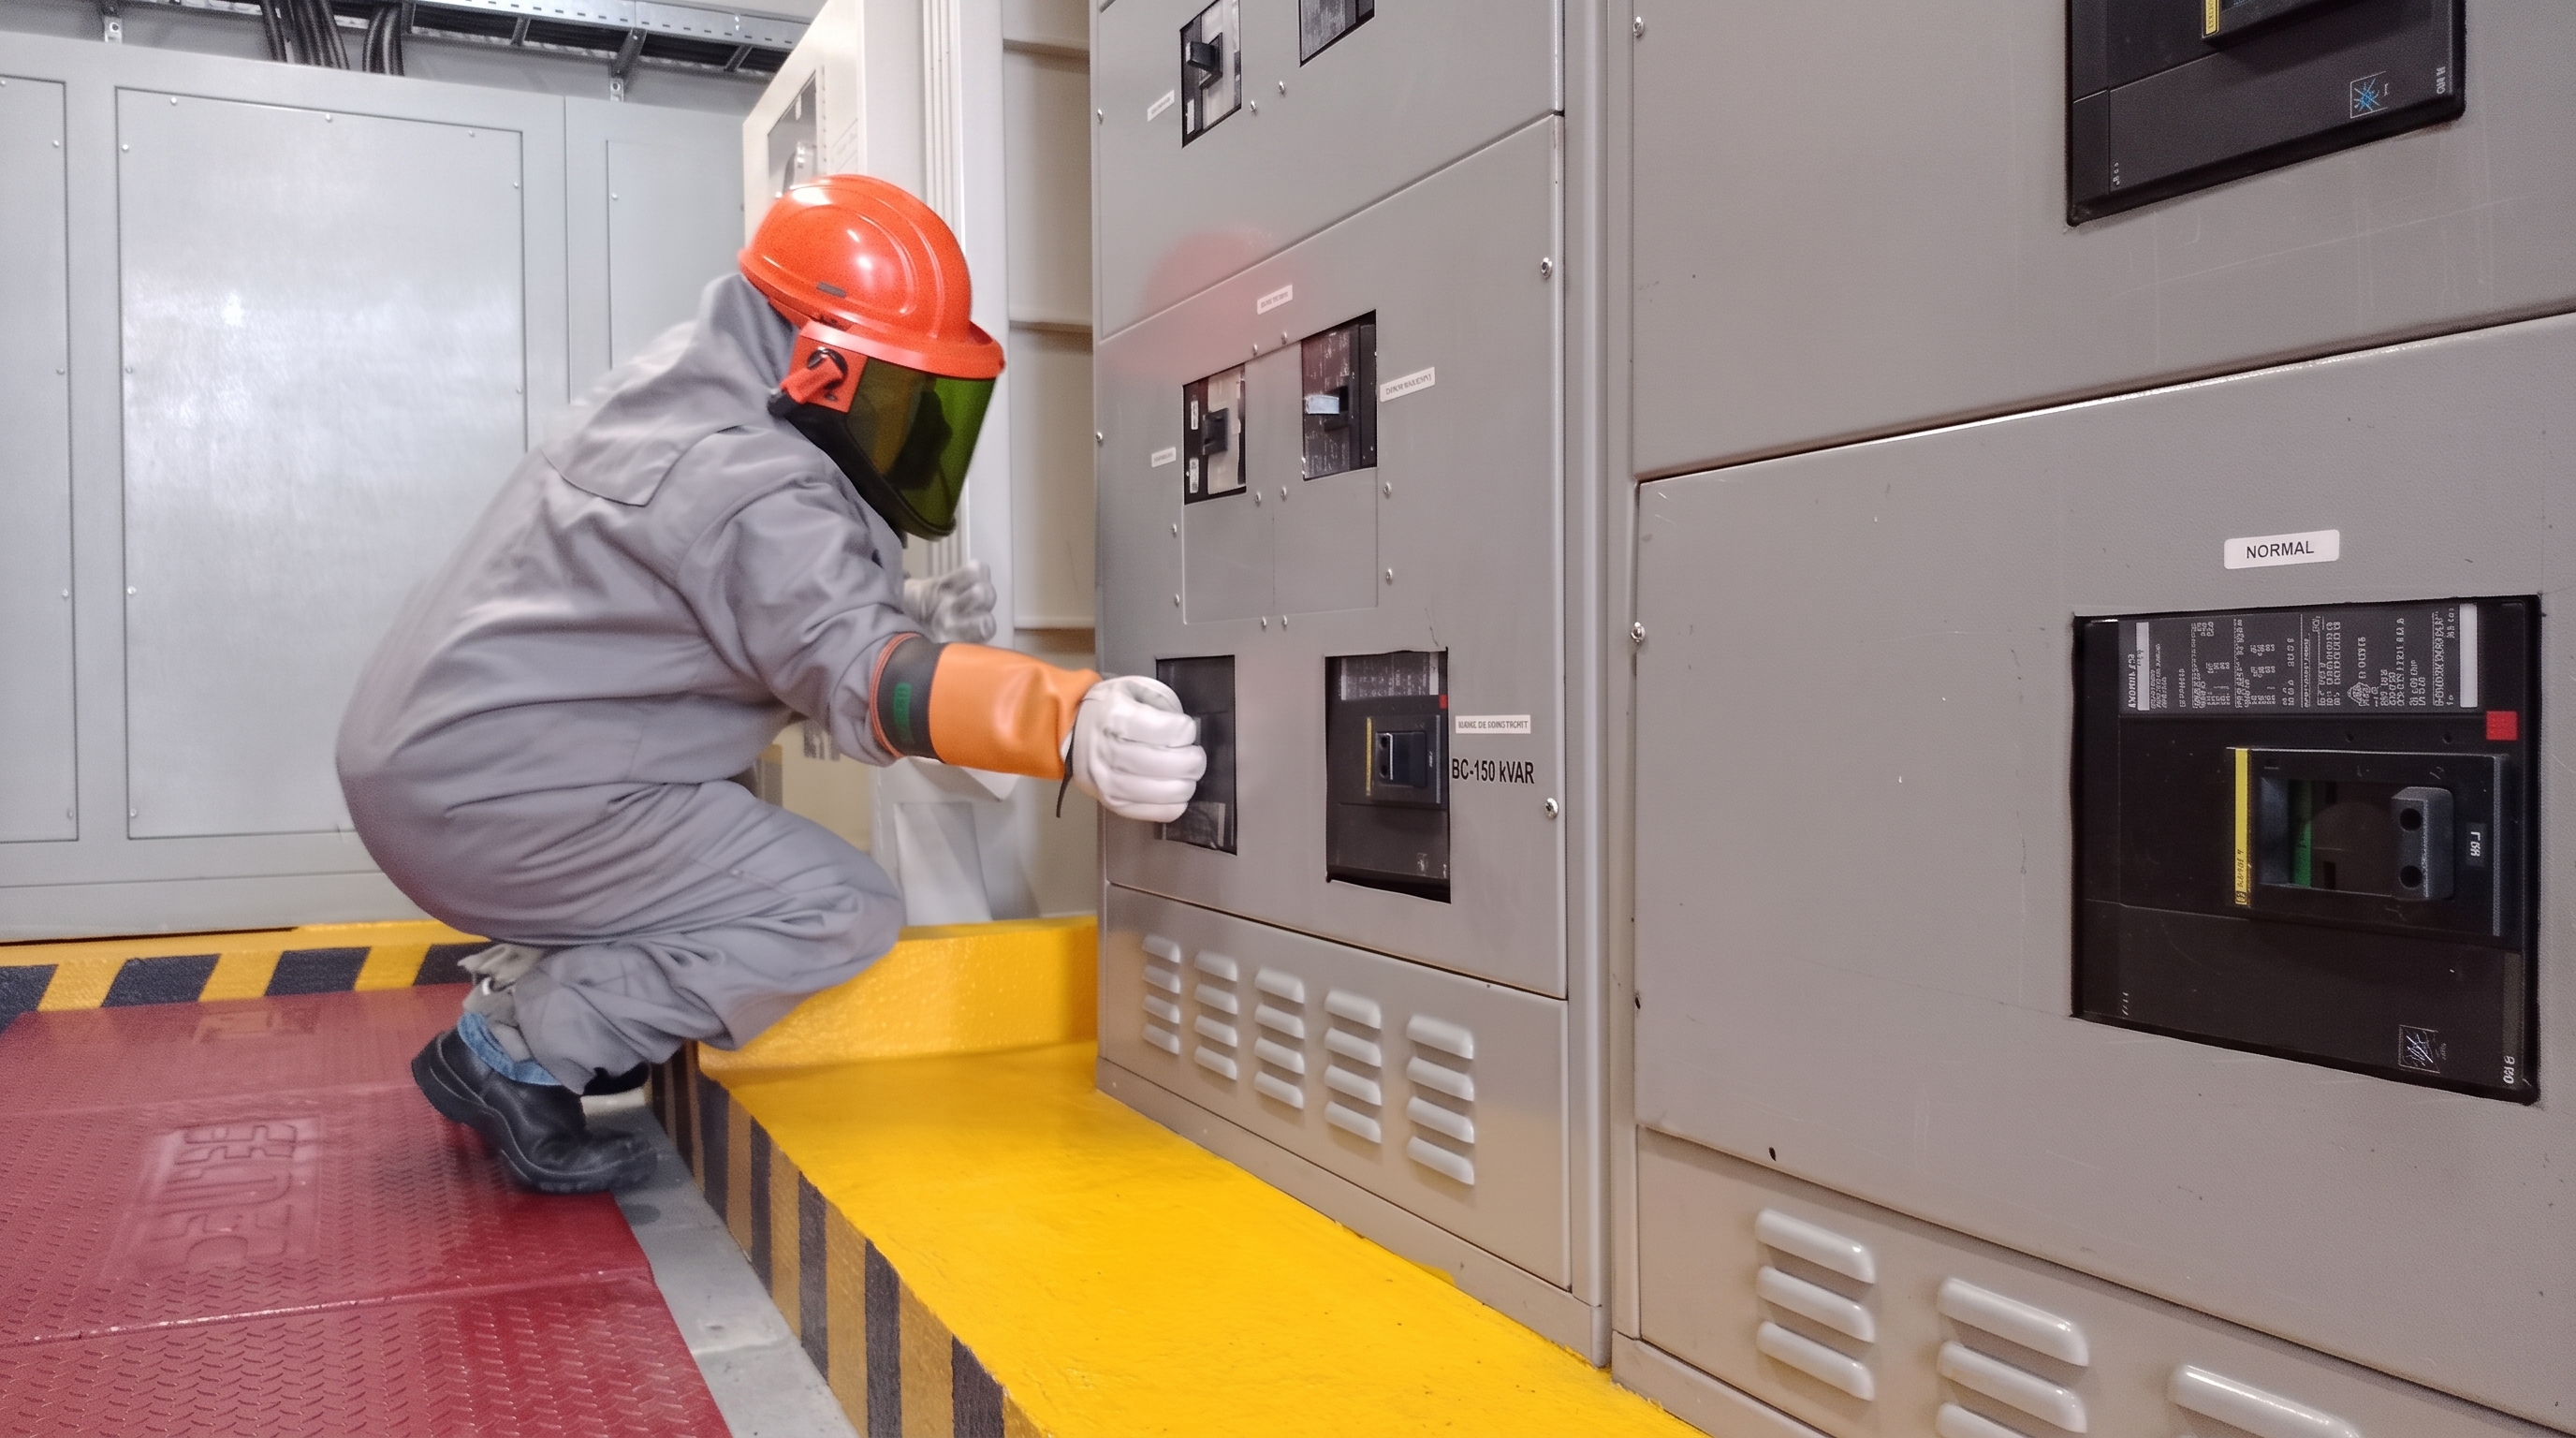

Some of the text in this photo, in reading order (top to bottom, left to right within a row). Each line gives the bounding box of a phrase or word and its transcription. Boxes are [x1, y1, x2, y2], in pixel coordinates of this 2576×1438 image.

[2247, 540, 2315, 559] NORMAL
[1452, 757, 1496, 782] BC-150
[1499, 760, 1535, 785] kVAR
